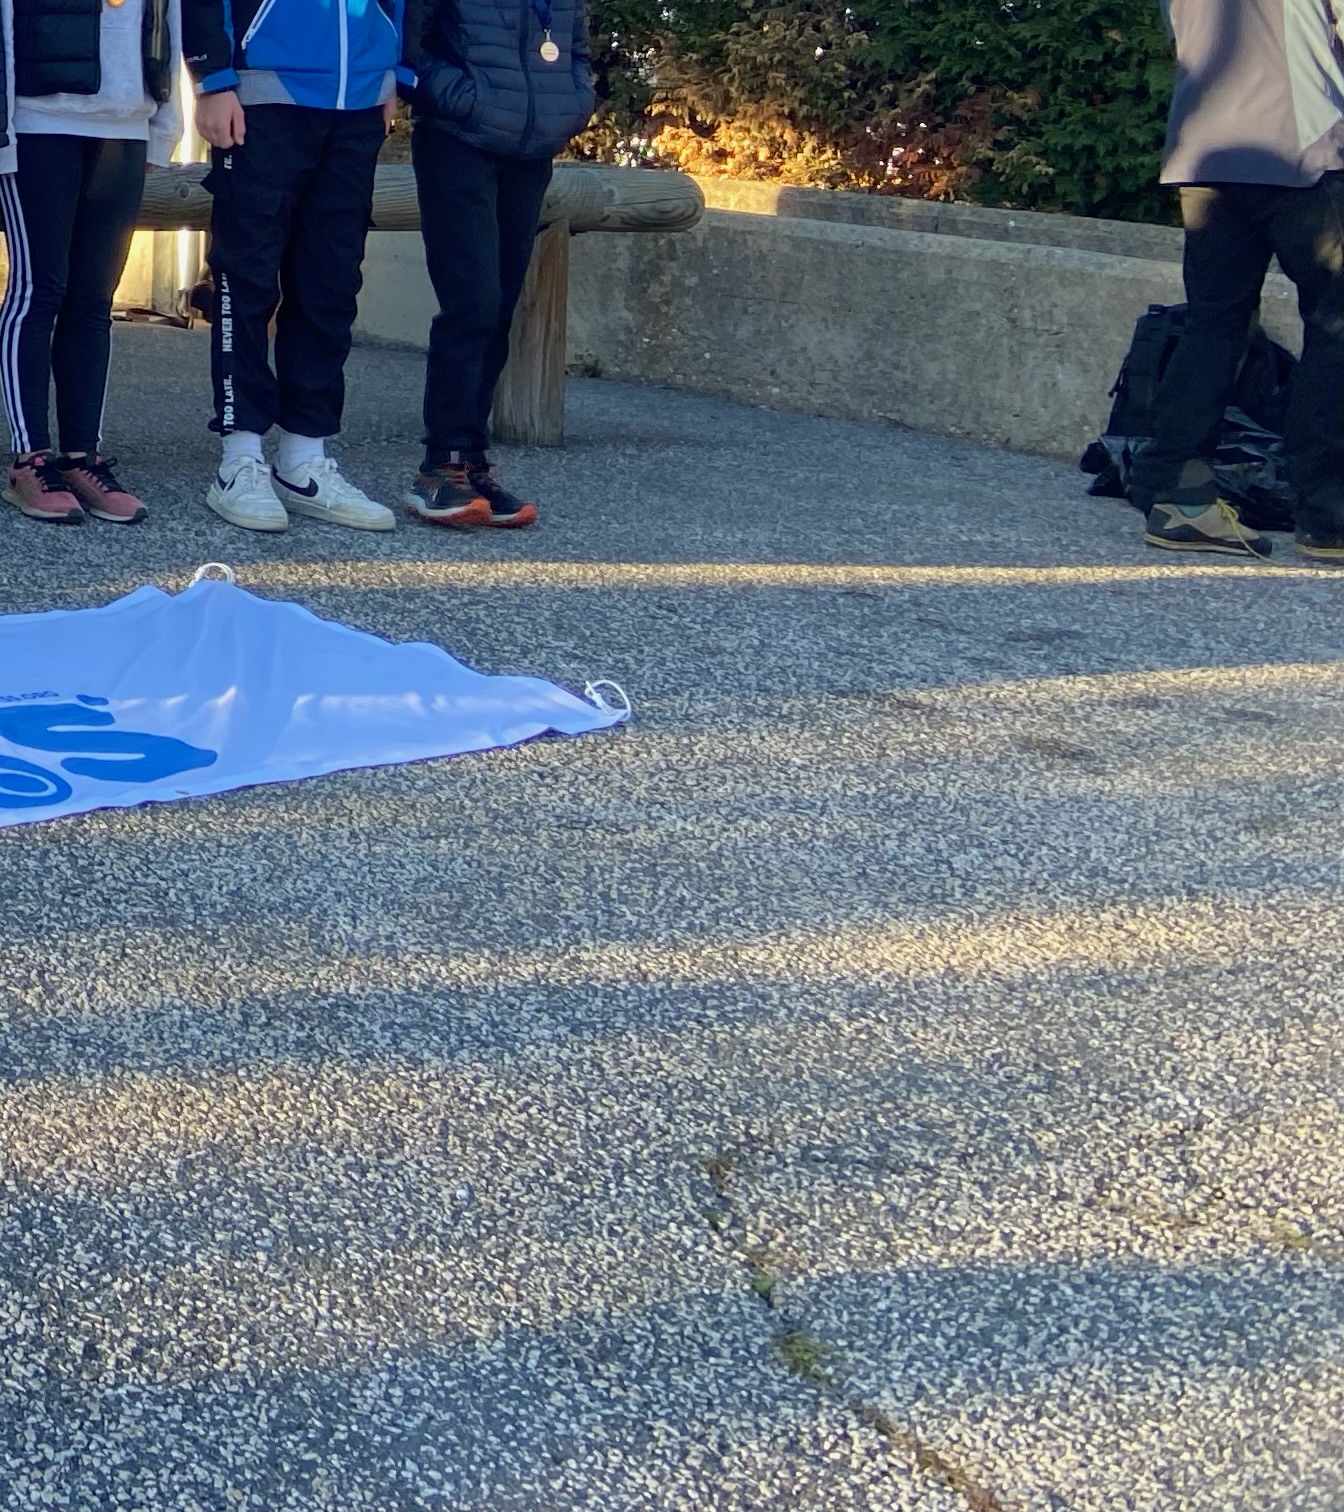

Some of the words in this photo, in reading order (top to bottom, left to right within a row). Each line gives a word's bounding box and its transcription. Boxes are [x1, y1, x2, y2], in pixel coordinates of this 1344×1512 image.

[221, 295, 232, 315] TOO
[221, 318, 233, 352] NEVER
[223, 374, 235, 403] LATE.
[223, 405, 235, 426] TOO
